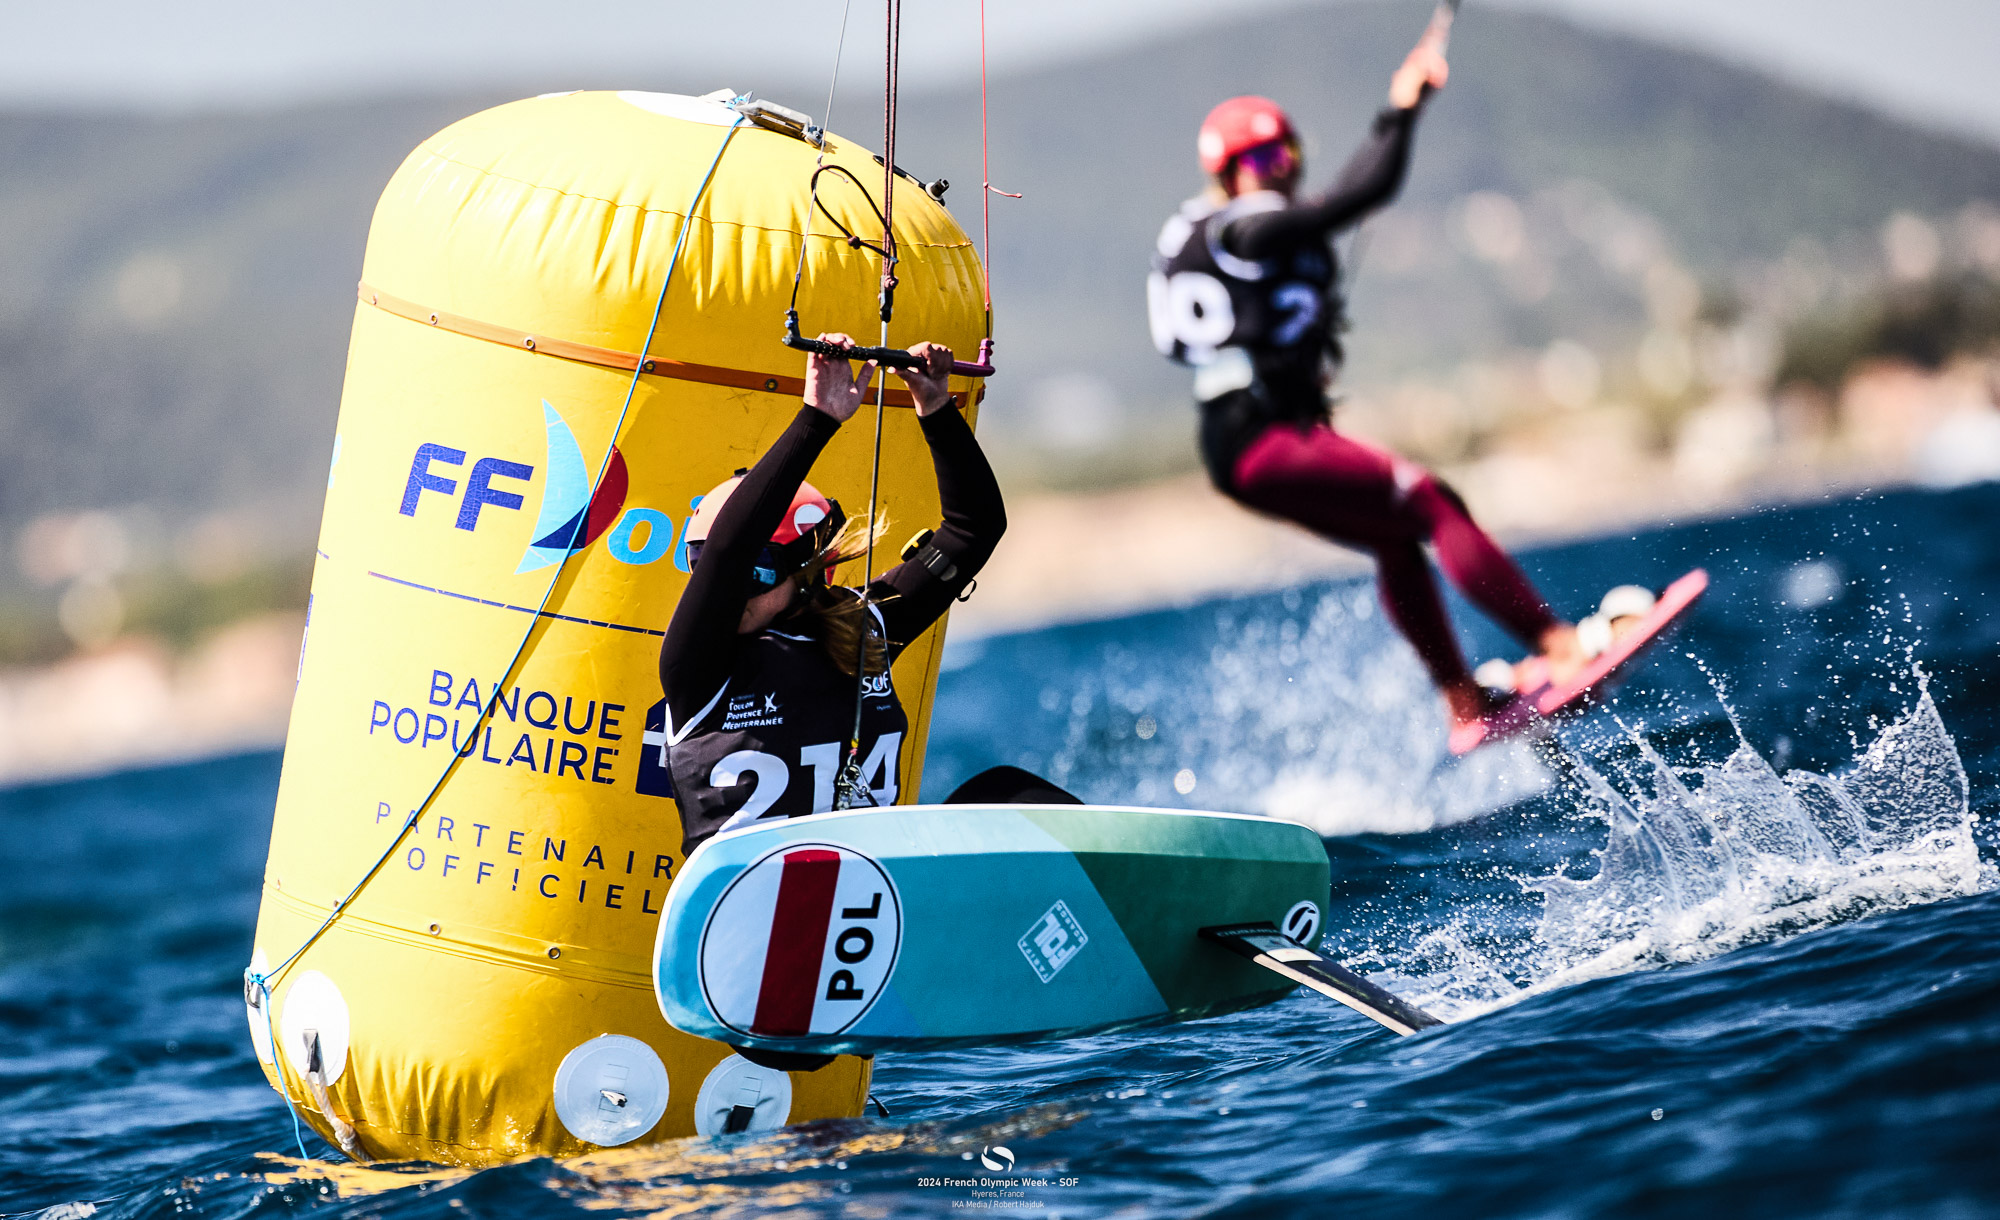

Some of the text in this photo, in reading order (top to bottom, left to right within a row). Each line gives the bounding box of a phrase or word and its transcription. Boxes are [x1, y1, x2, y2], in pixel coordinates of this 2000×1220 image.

[369, 700, 620, 785] POPULAIRE
[429, 669, 626, 741] BANQUE
[726, 709, 763, 721] PROVENCE
[709, 731, 902, 832] 214
[375, 801, 676, 880] PARTENAIR
[407, 847, 659, 915] OFFICIEL
[825, 893, 882, 1001] POL
